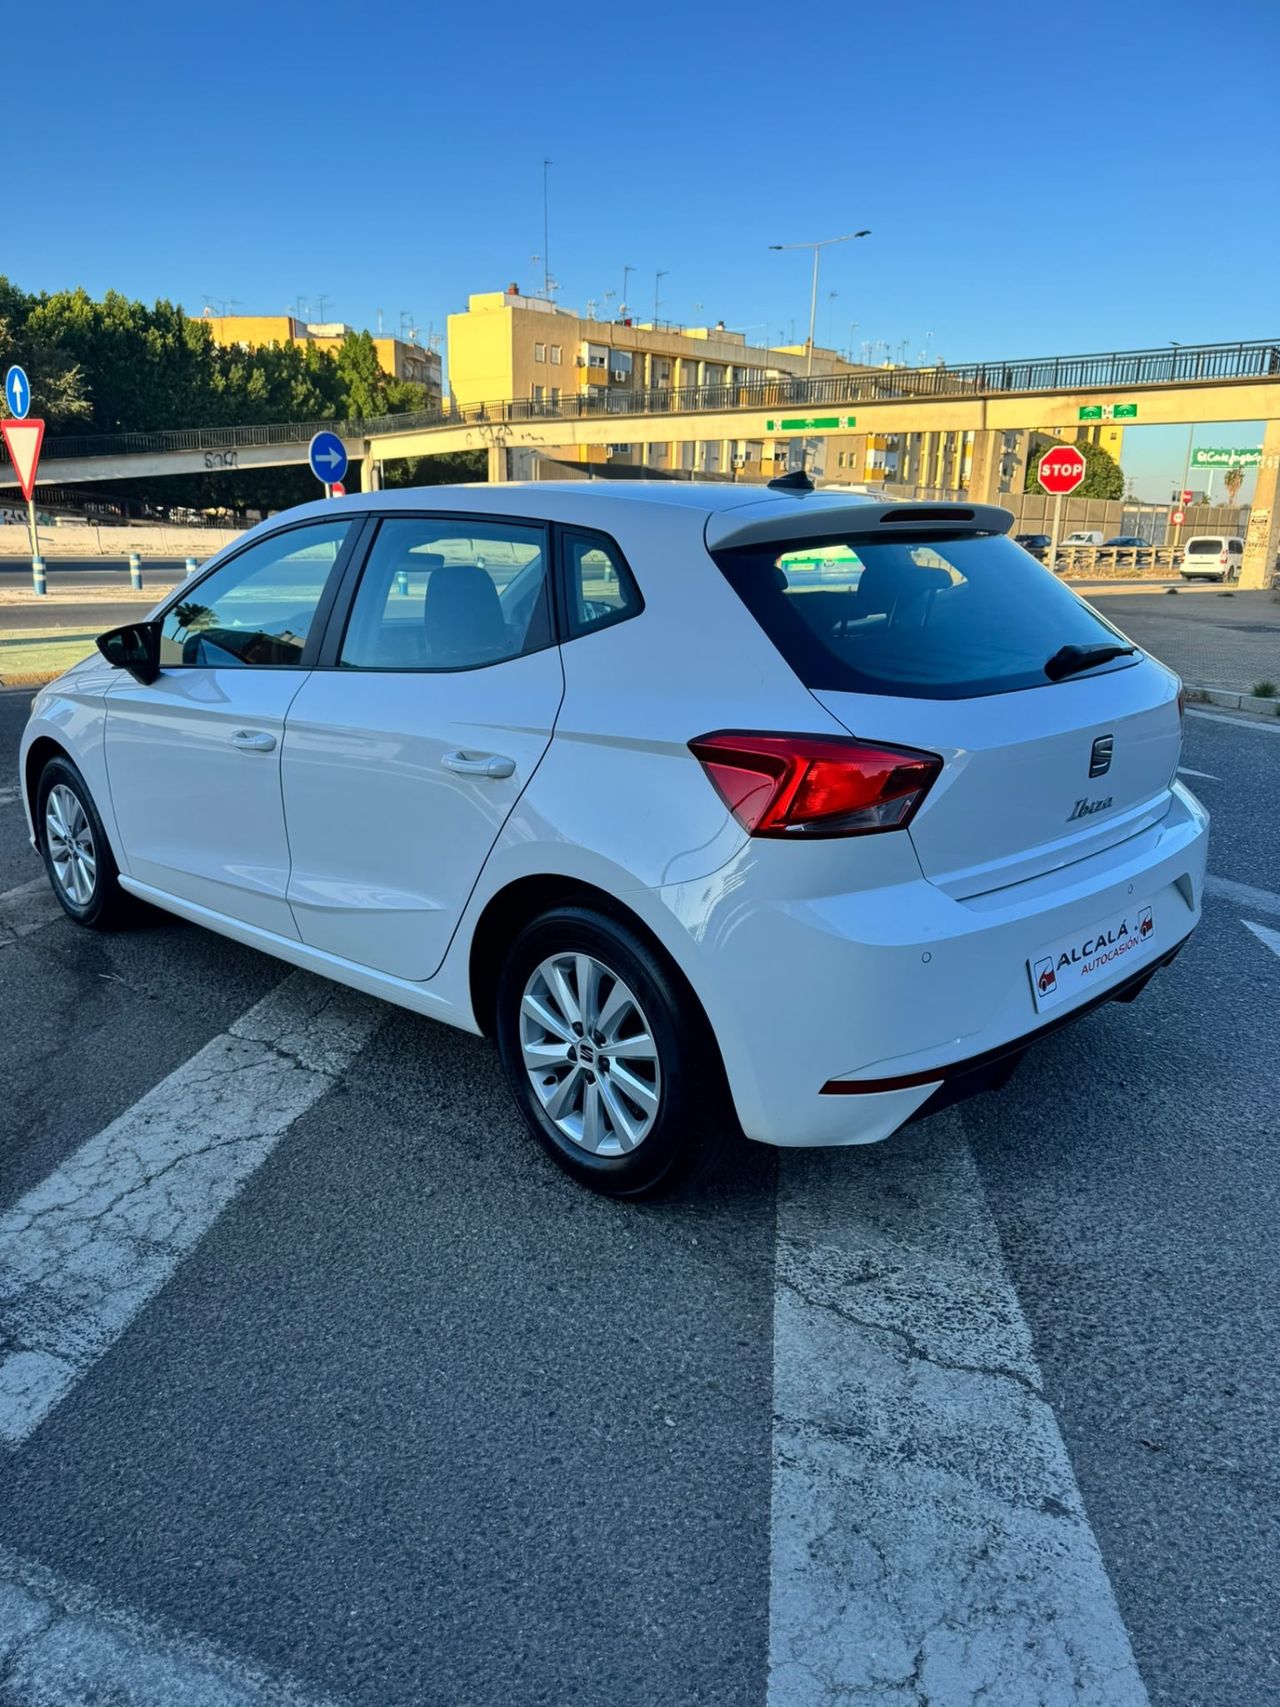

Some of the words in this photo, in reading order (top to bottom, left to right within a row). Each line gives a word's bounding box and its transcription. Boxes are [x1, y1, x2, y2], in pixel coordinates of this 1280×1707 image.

[1042, 464, 1082, 477] STOP
[1066, 796, 1112, 822] Ibiza
[1056, 919, 1128, 971] ALCALÁ
[1081, 936, 1139, 976] AUTOCASIÓN
